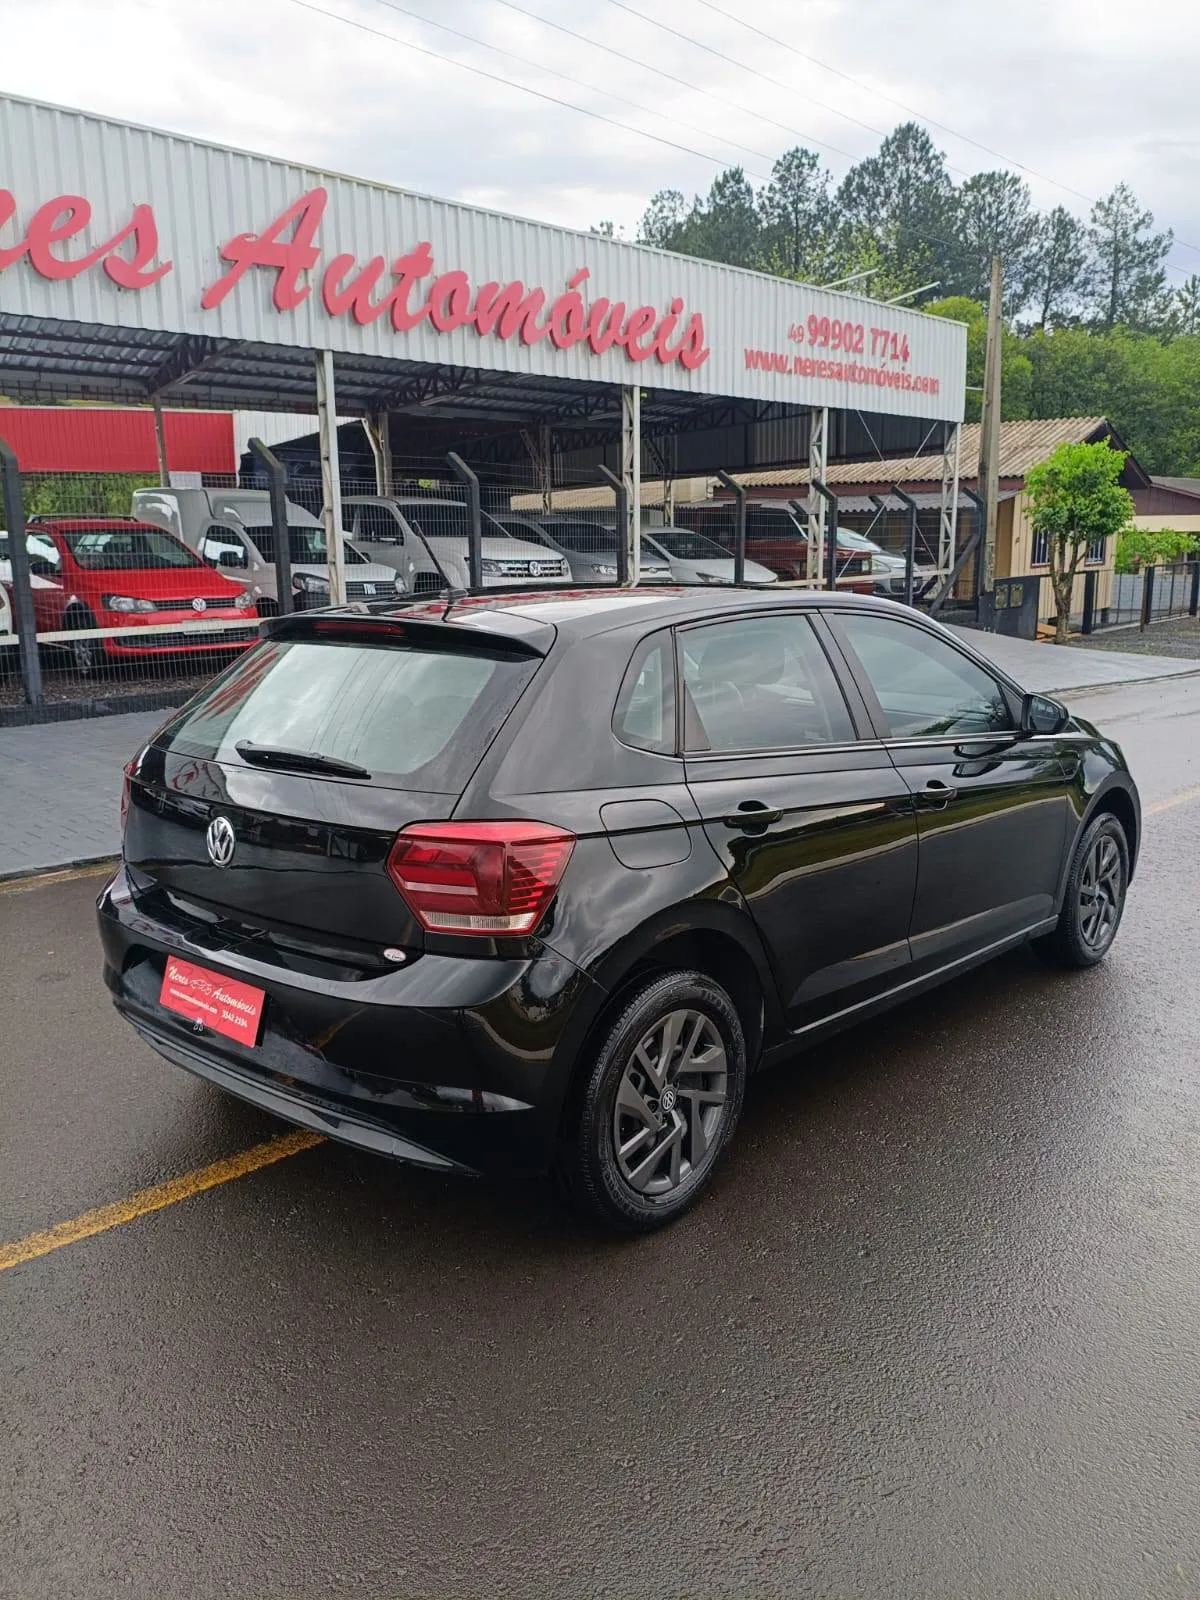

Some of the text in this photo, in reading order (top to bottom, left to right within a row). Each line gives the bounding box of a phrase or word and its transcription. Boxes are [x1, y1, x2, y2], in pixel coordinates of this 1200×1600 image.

[201, 186, 711, 371] Automóveis
[808, 314, 865, 354] 99902
[870, 327, 910, 363] 7714
